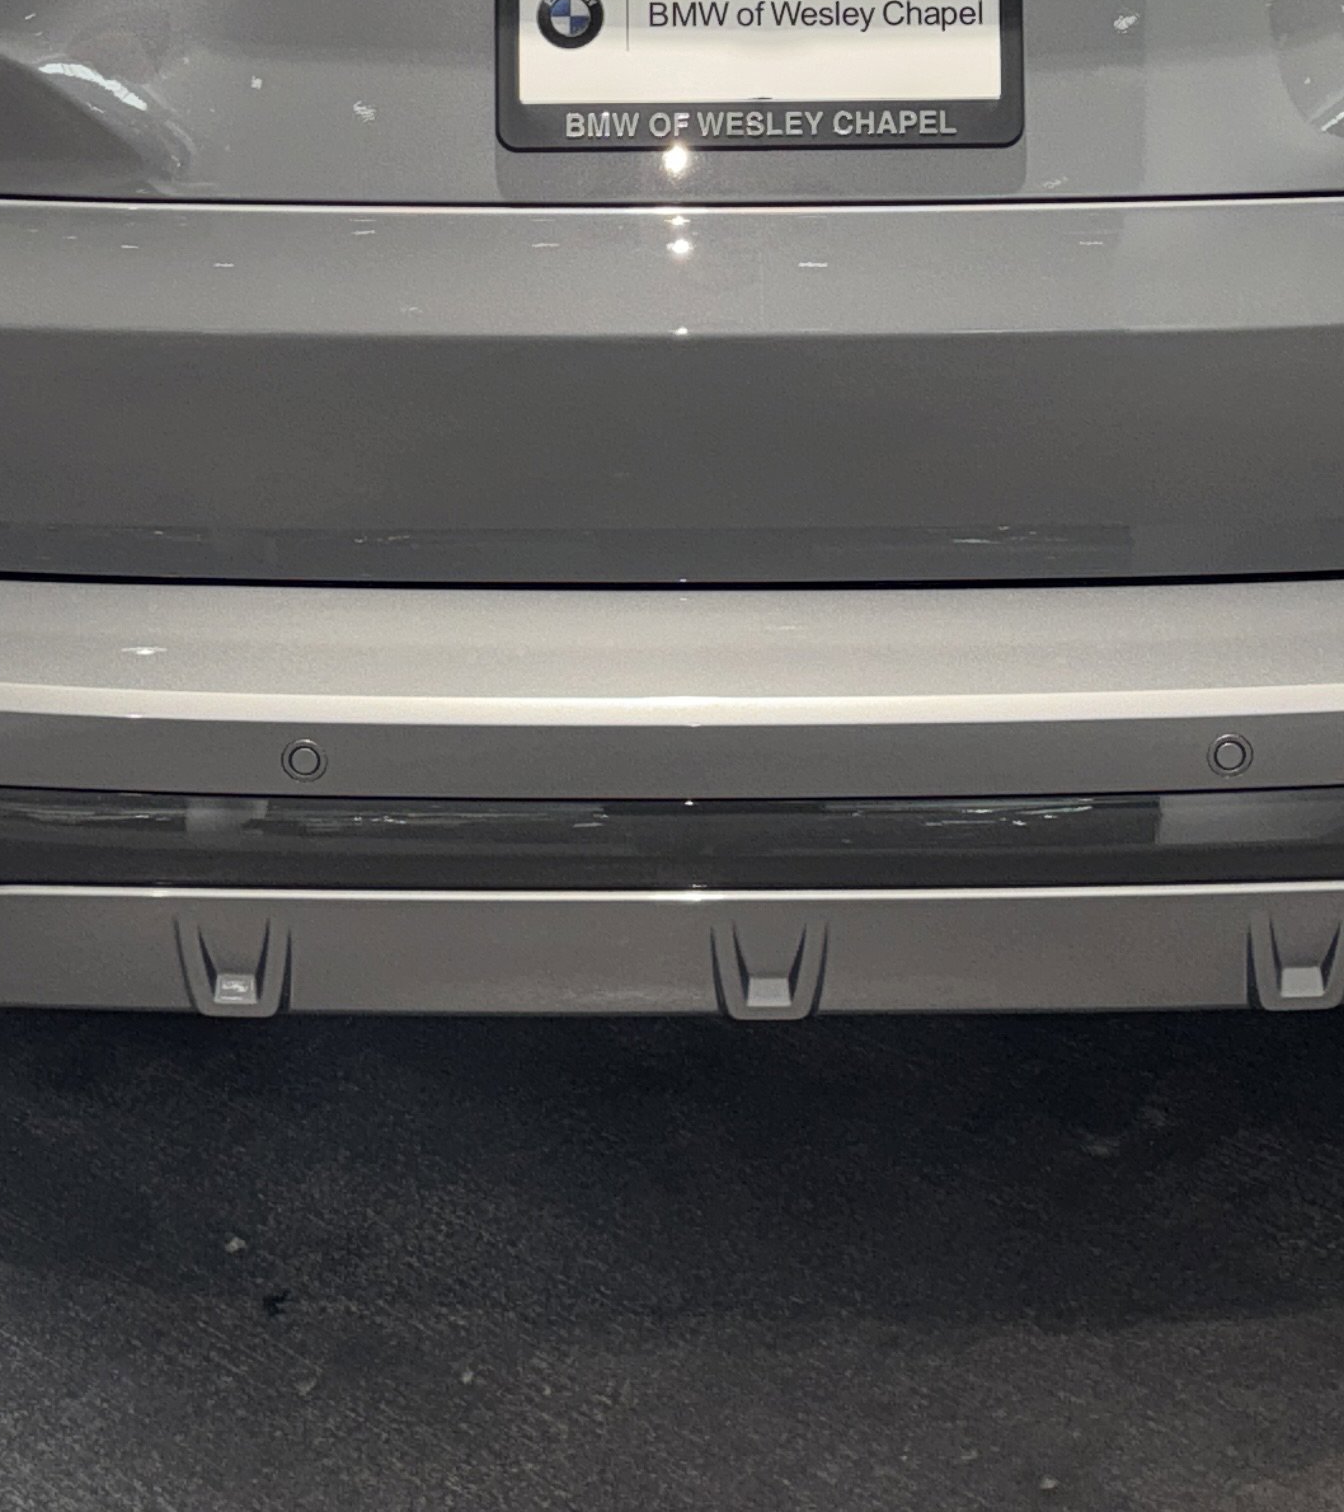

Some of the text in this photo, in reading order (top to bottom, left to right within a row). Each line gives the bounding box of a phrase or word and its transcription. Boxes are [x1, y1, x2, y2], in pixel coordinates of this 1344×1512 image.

[649, 0, 983, 32] BMW of Wesley Chapel
[565, 110, 958, 137] BMW OF WESLEY CHAPEL
